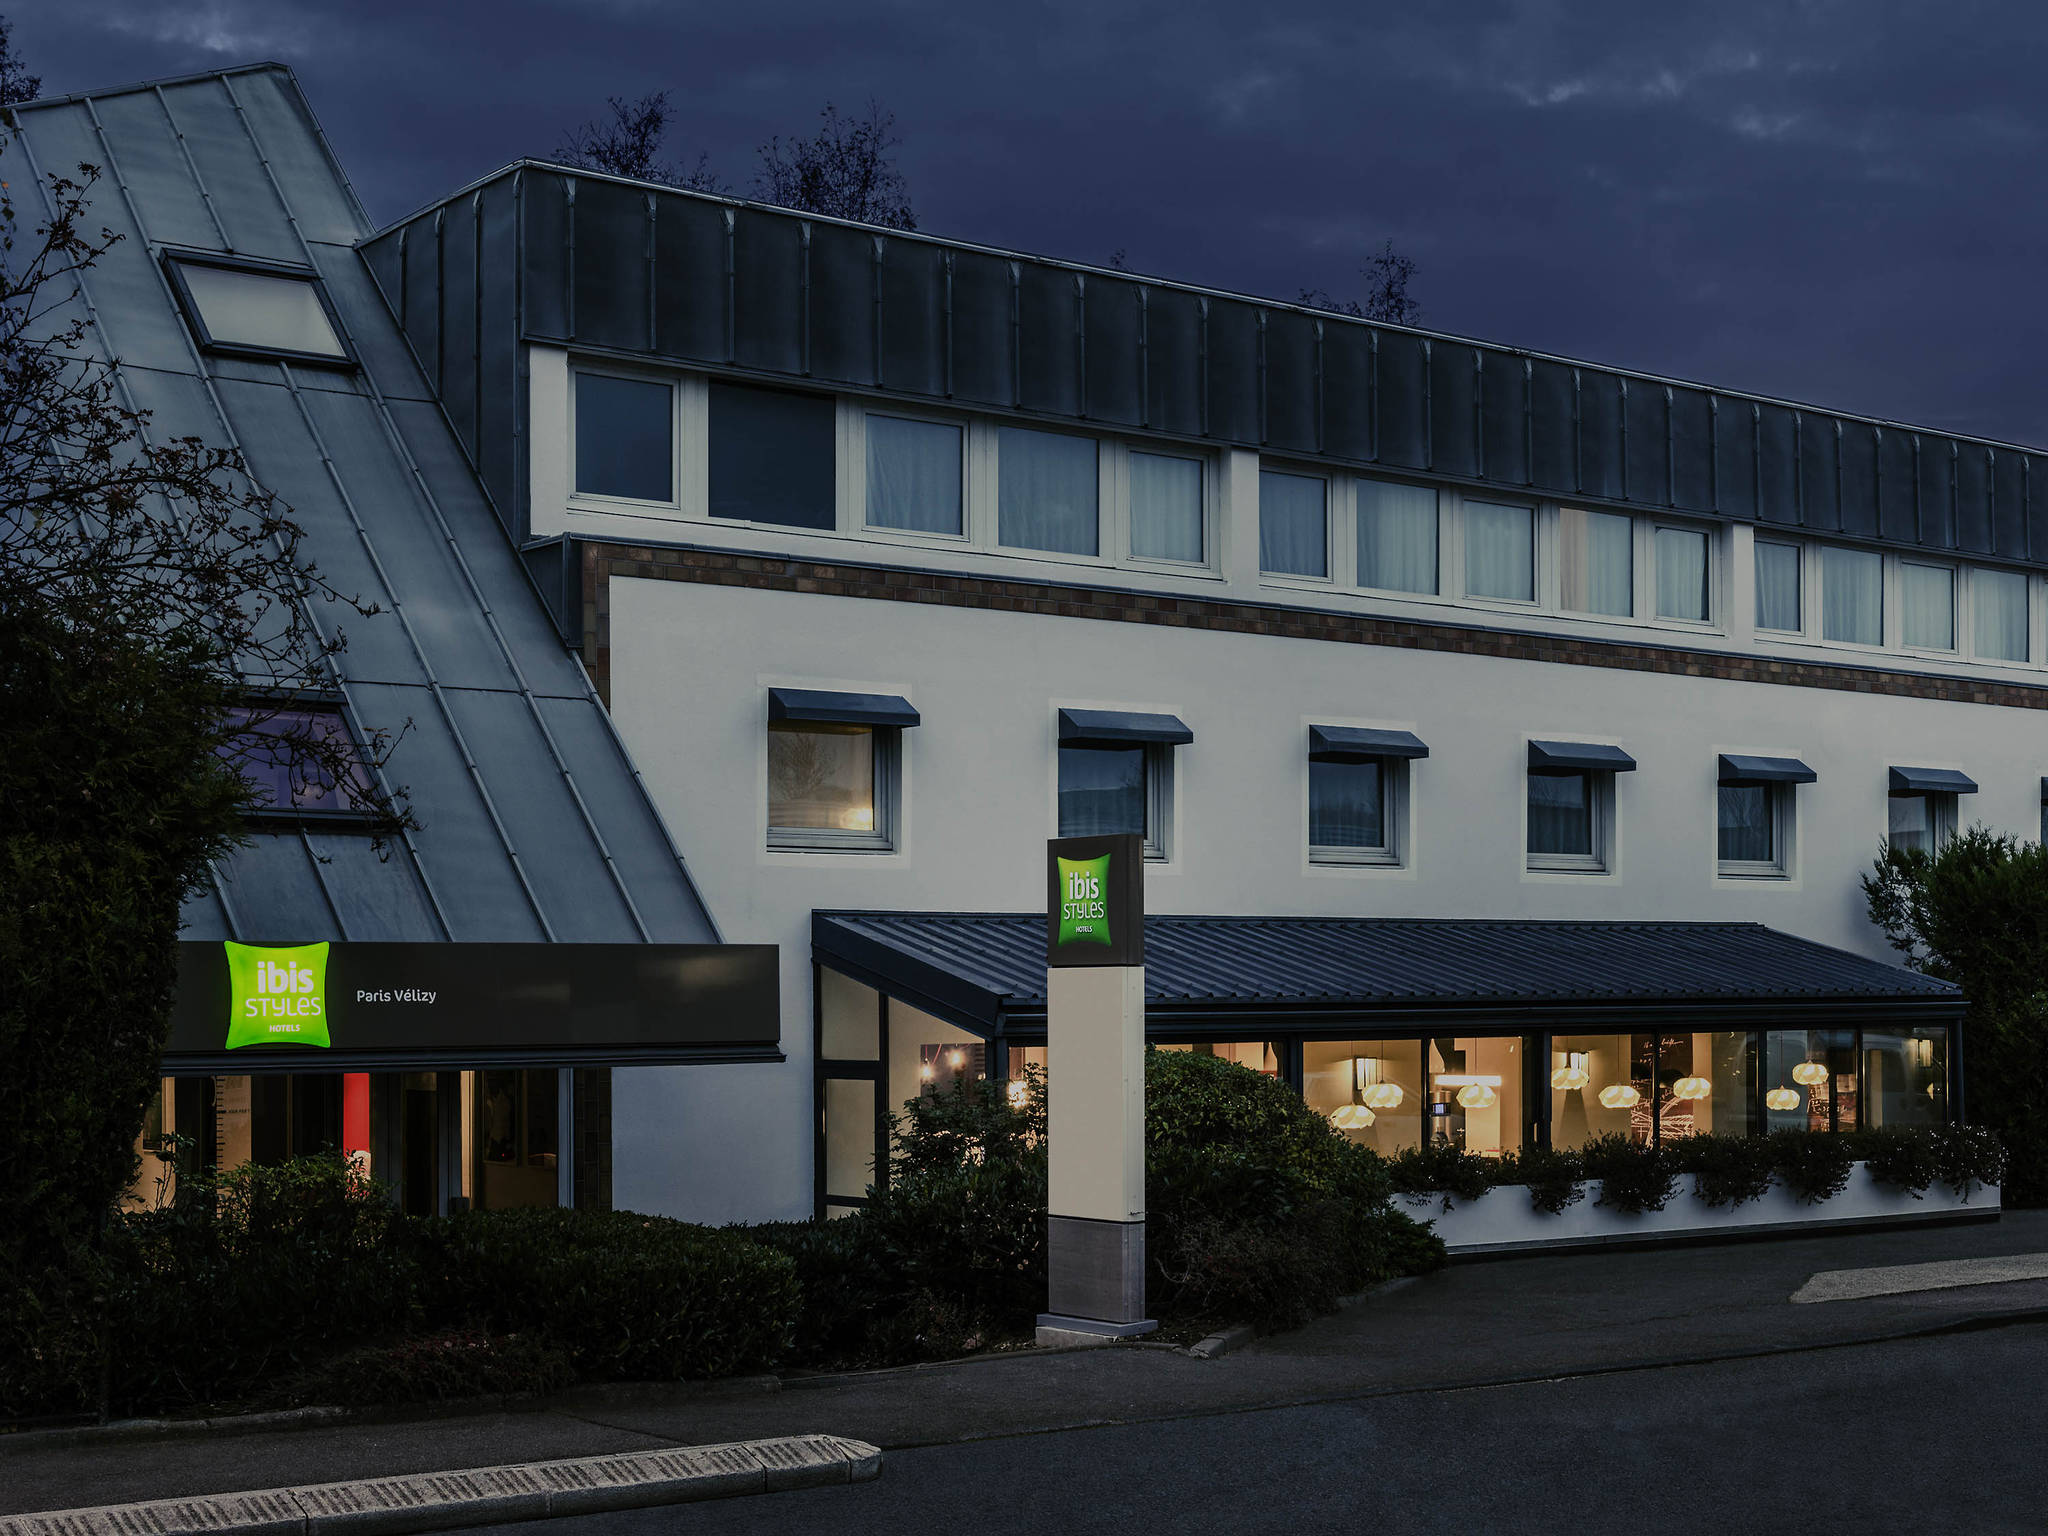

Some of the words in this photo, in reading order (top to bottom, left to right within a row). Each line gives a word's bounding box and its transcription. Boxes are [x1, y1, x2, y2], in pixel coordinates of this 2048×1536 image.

[1069, 871, 1099, 900] ibis
[1075, 925, 1093, 933] HOTELS
[257, 961, 314, 994] ibis
[357, 990, 391, 1002] Paris
[394, 989, 437, 1004] Vélizy
[269, 1024, 300, 1032] HOTELS
